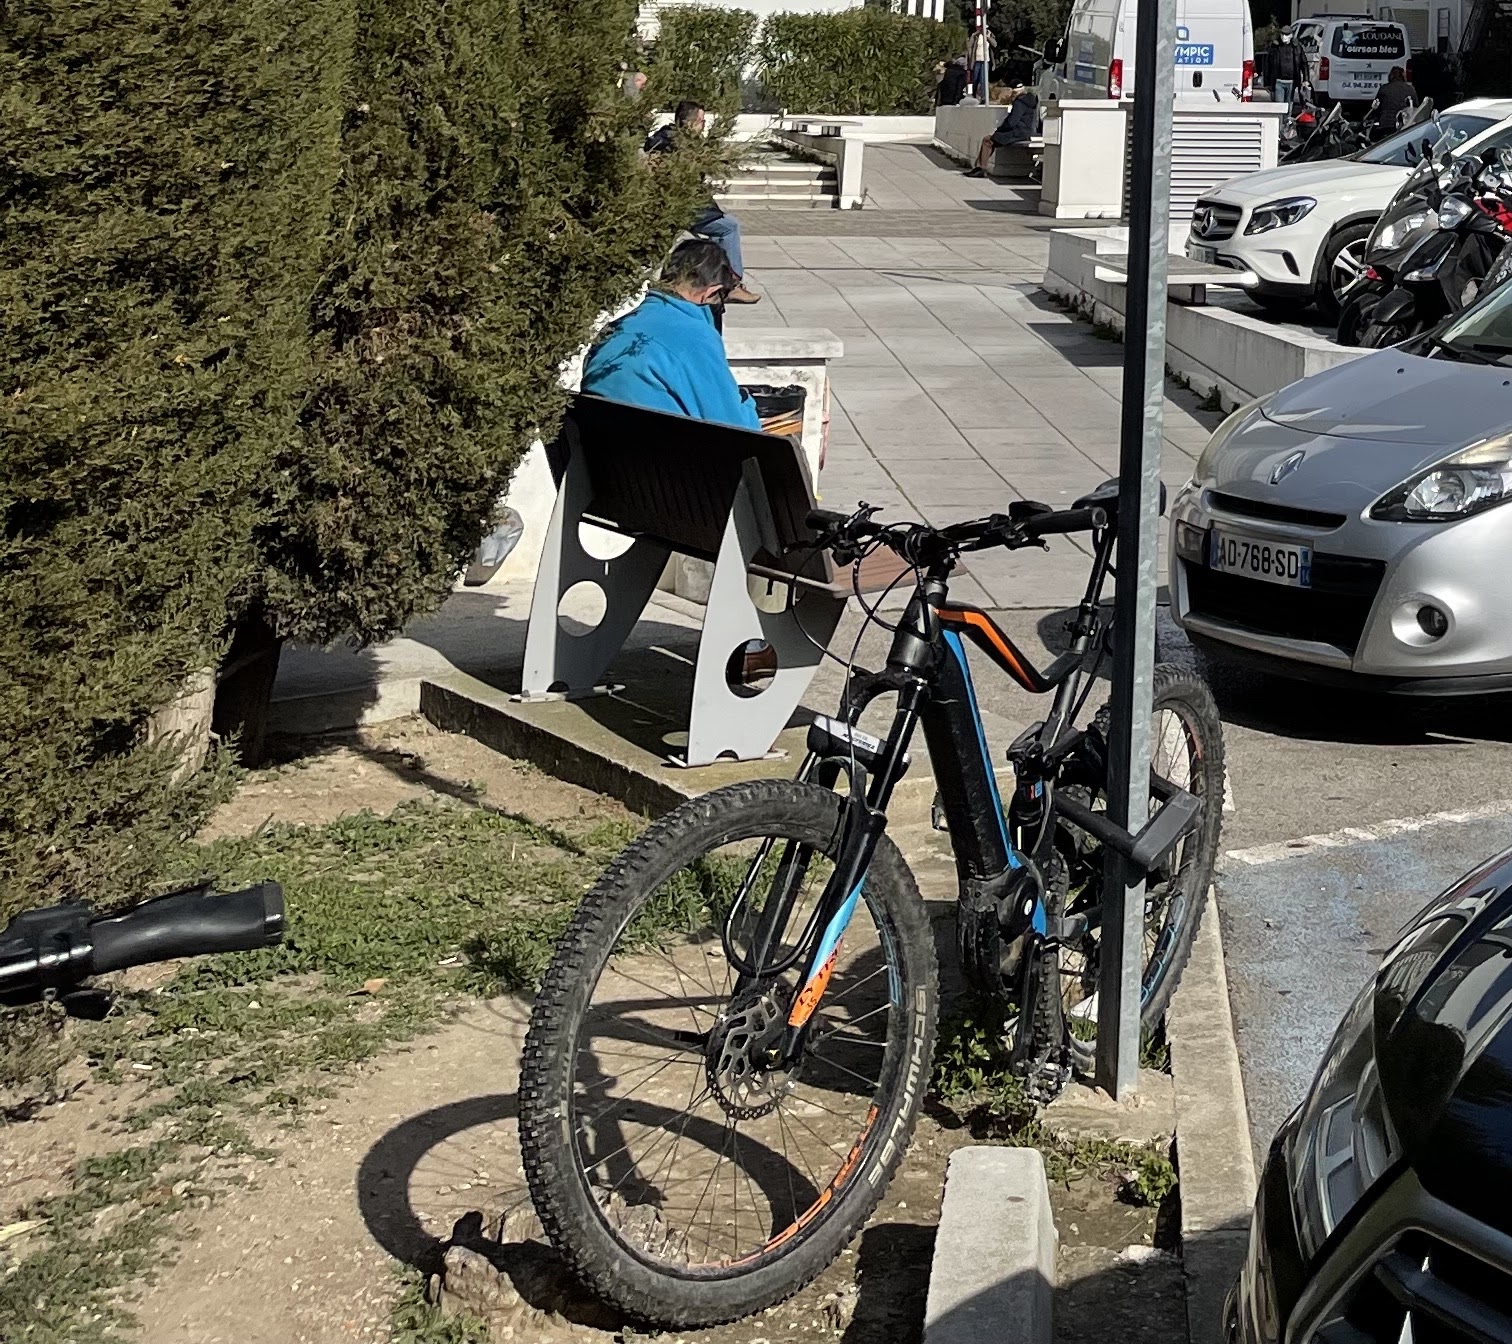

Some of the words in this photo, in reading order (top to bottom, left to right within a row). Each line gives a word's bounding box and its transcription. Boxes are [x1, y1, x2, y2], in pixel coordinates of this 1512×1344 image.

[1174, 46, 1210, 57] YMPIC
[1379, 45, 1398, 54] bleu
[1218, 537, 1299, 579] AD-768-SD
[868, 984, 928, 1189] SCHWALBE
